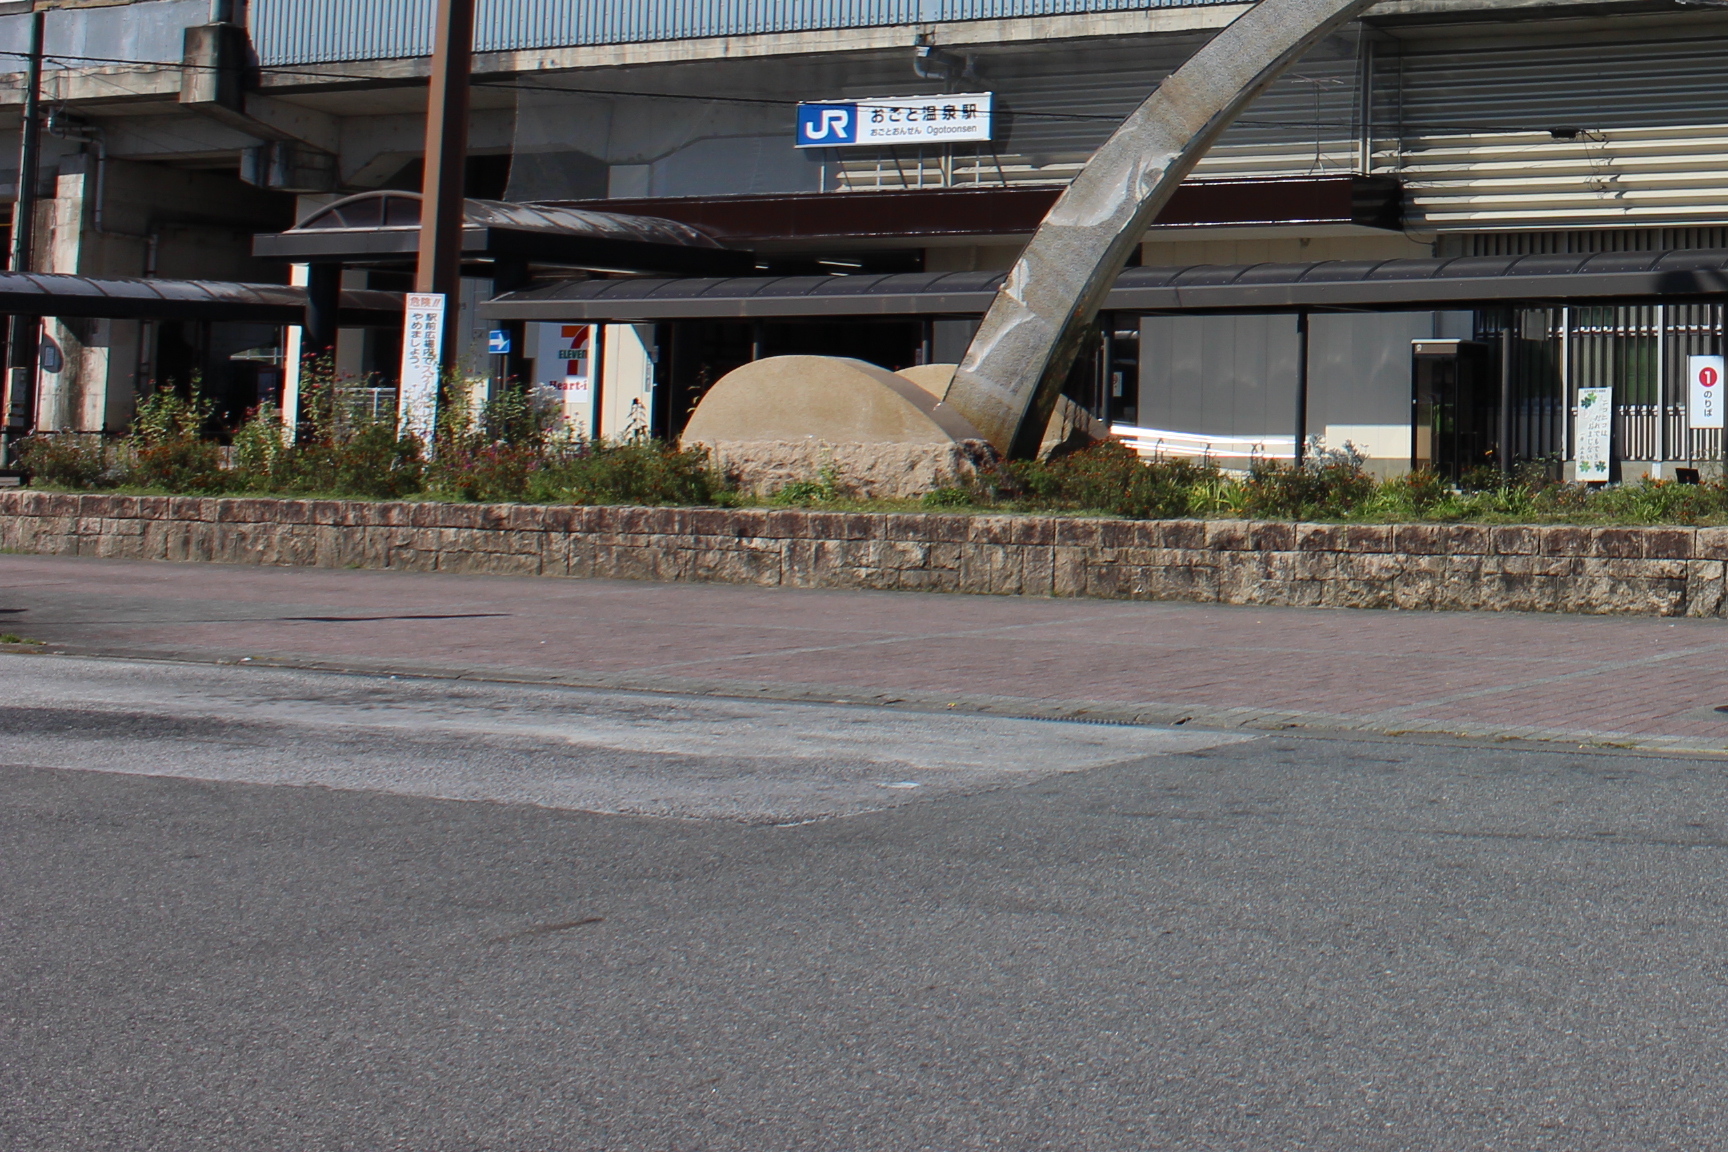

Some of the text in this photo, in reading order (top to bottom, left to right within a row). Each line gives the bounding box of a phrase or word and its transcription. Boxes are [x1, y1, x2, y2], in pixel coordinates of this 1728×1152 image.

[805, 109, 849, 140] JR
[871, 104, 978, 124] おごと温泉駅
[869, 125, 978, 137] おごとおんせん Ogotoonsen
[1703, 390, 1713, 418] のりば
